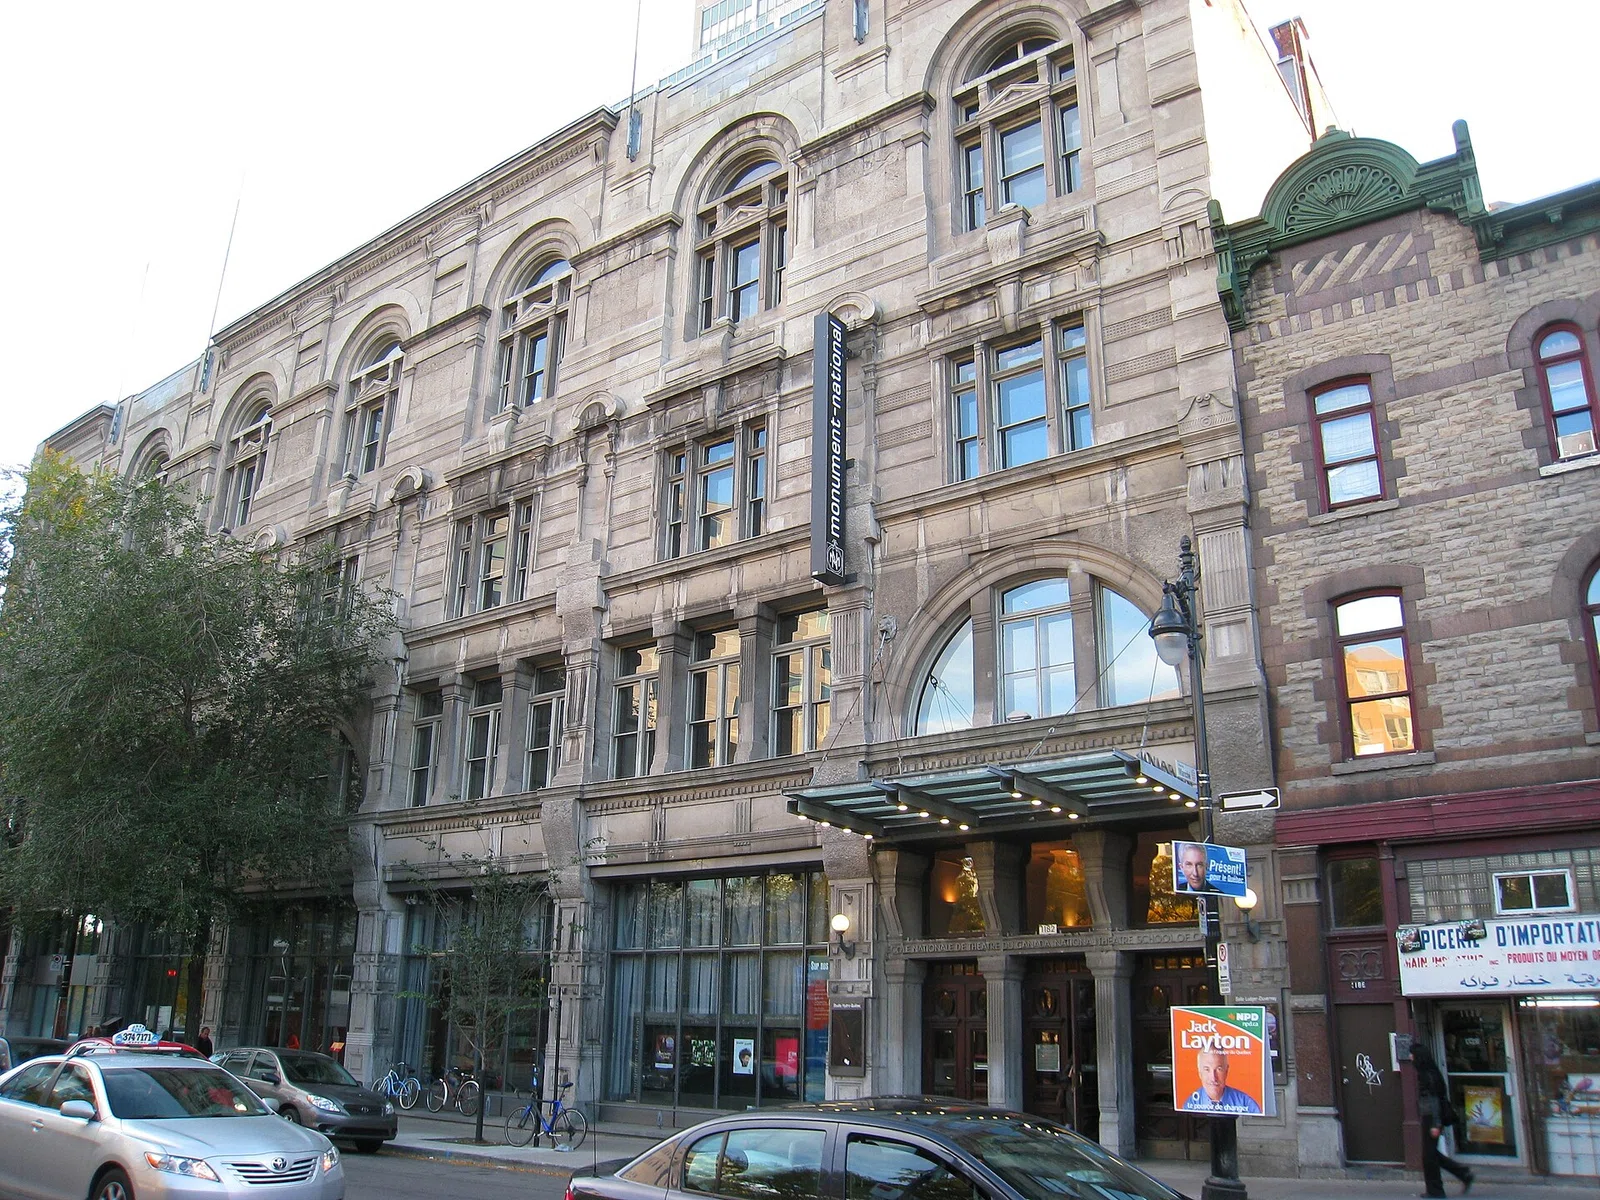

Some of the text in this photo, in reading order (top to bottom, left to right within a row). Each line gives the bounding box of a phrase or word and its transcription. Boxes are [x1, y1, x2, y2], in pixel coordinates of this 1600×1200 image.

[829, 320, 843, 538] monument-national
[1209, 860, 1242, 875] Présent!
[1041, 924, 1056, 933] 1182
[1507, 952, 1545, 964] PRODUITS
[1560, 949, 1588, 962] MOYEN
[1236, 1012, 1259, 1021] NPD
[1187, 1020, 1217, 1033] Jack
[1181, 1030, 1250, 1053] Layton
